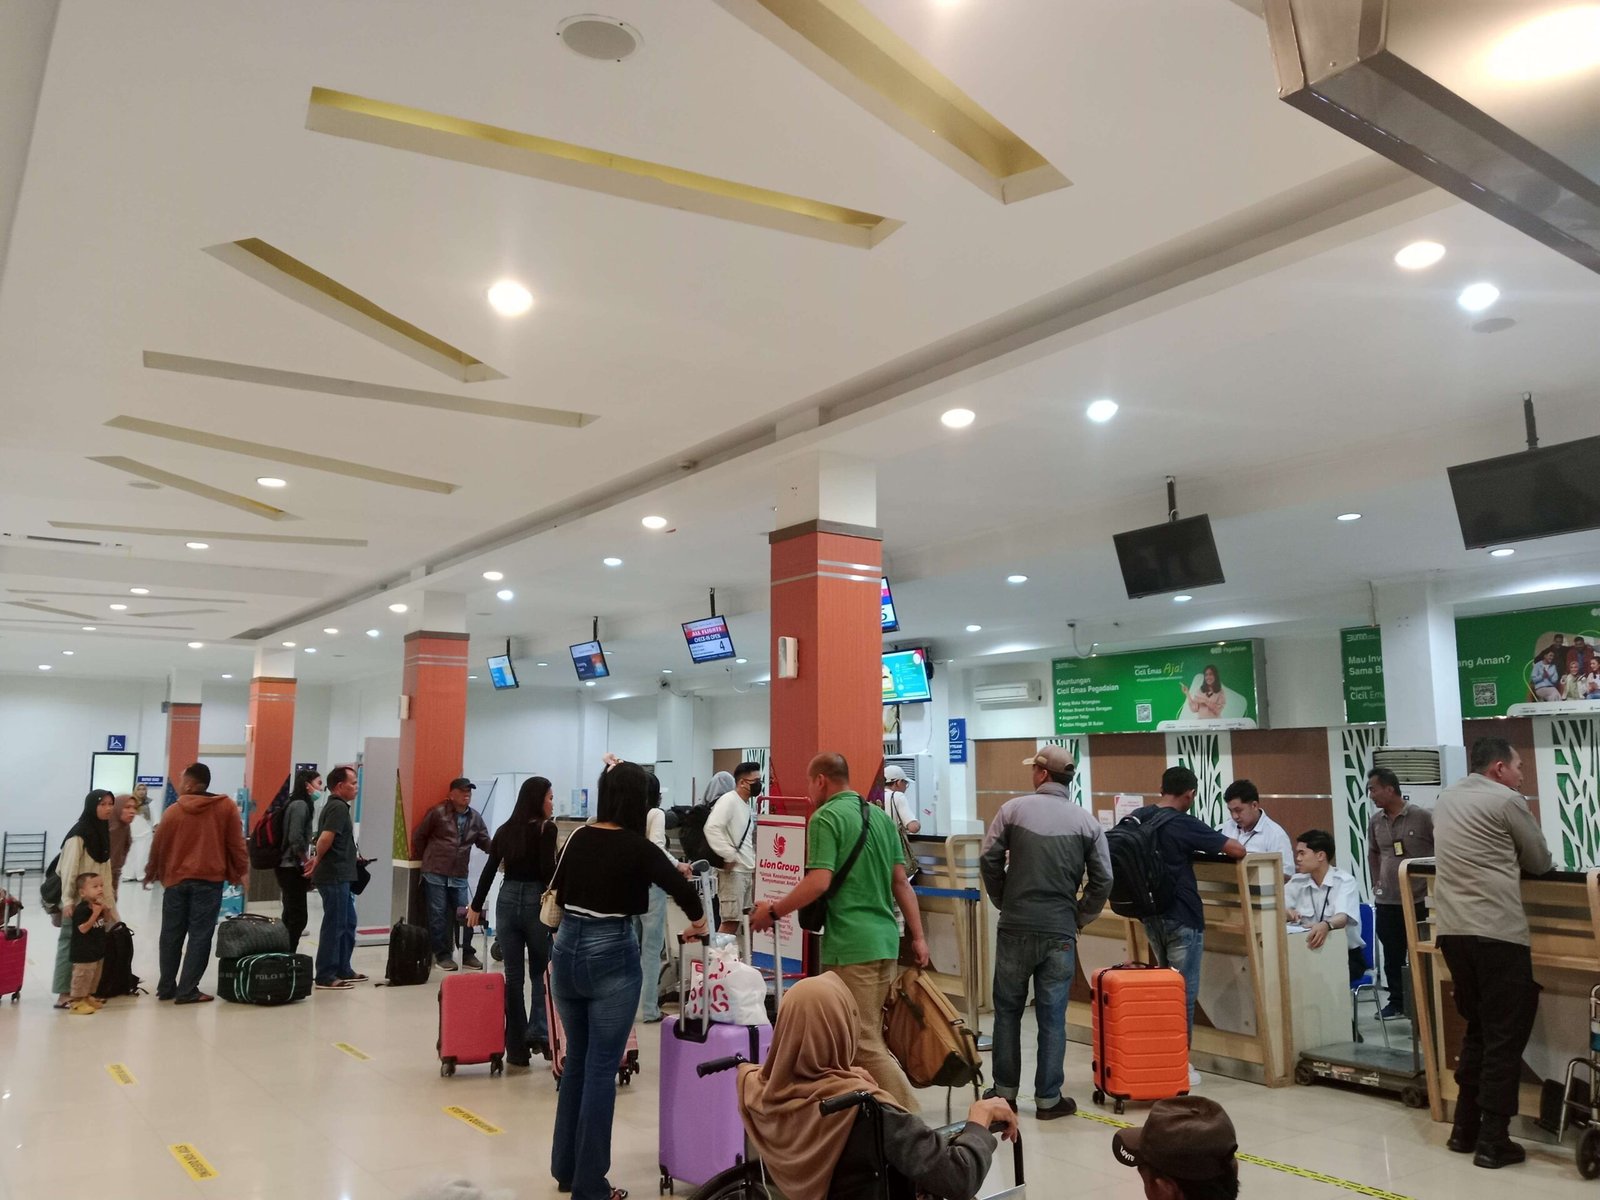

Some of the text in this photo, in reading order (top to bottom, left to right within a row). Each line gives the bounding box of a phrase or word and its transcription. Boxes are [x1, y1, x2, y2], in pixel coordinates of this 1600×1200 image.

[719, 640, 726, 651] 4
[1348, 655, 1383, 665] Mau Inv
[1458, 654, 1512, 669] ang Aman?
[1163, 662, 1184, 677] Aja!
[1349, 667, 1373, 676] Sama
[1056, 677, 1091, 686] Keuntungan
[1056, 684, 1119, 695] Cicil Emas Pegadaian
[1350, 691, 1368, 700] Cicil
[759, 858, 800, 874] Lion Group
